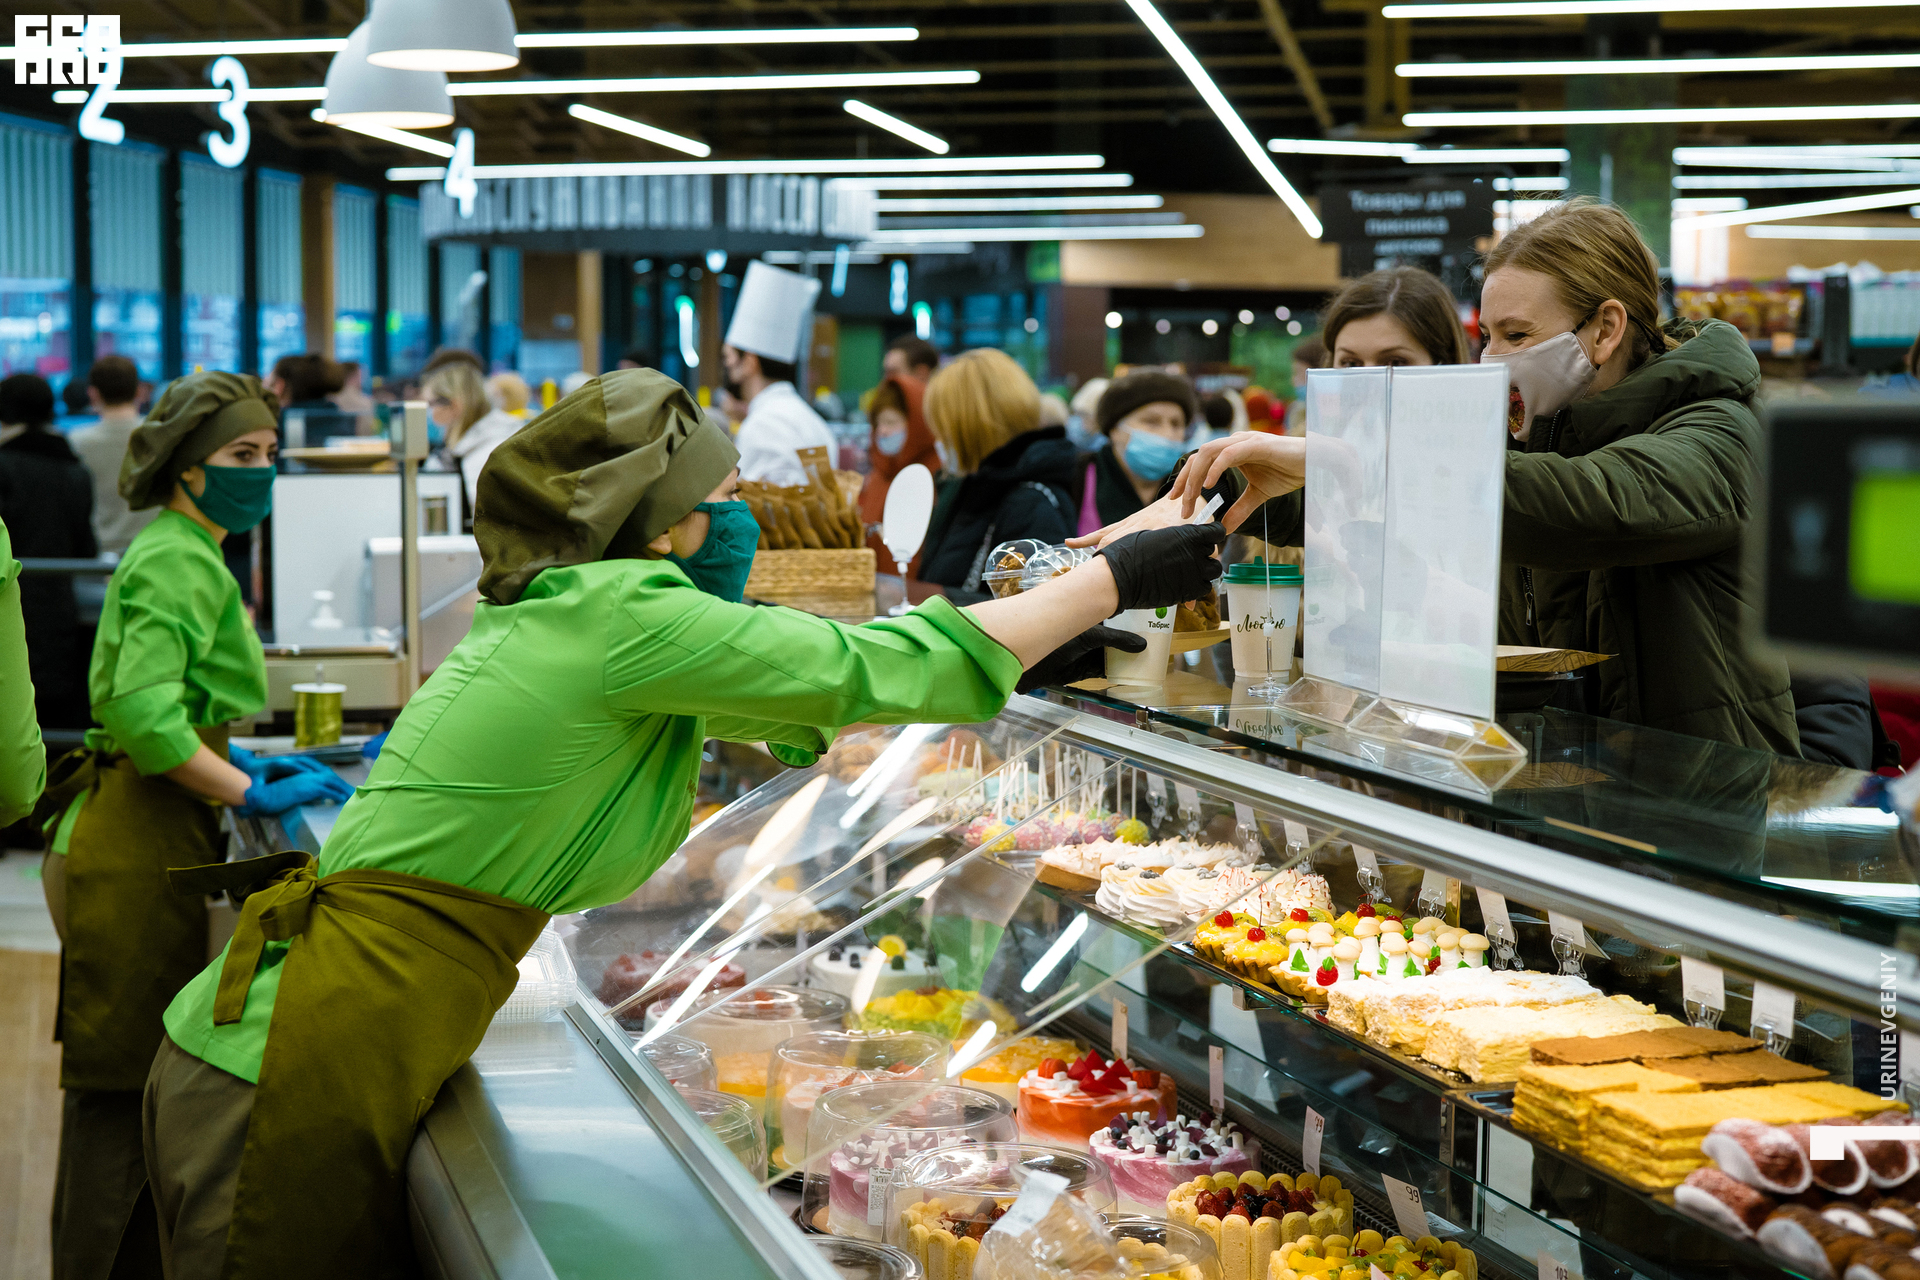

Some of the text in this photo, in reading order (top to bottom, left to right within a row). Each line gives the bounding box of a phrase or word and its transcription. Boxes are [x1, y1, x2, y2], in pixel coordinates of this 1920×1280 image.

[207, 56, 250, 168] 3
[444, 127, 478, 219] 4
[1348, 190, 1466, 214] Товары для
[1148, 620, 1171, 630] Табрис
[1405, 1185, 1420, 1204] 99
